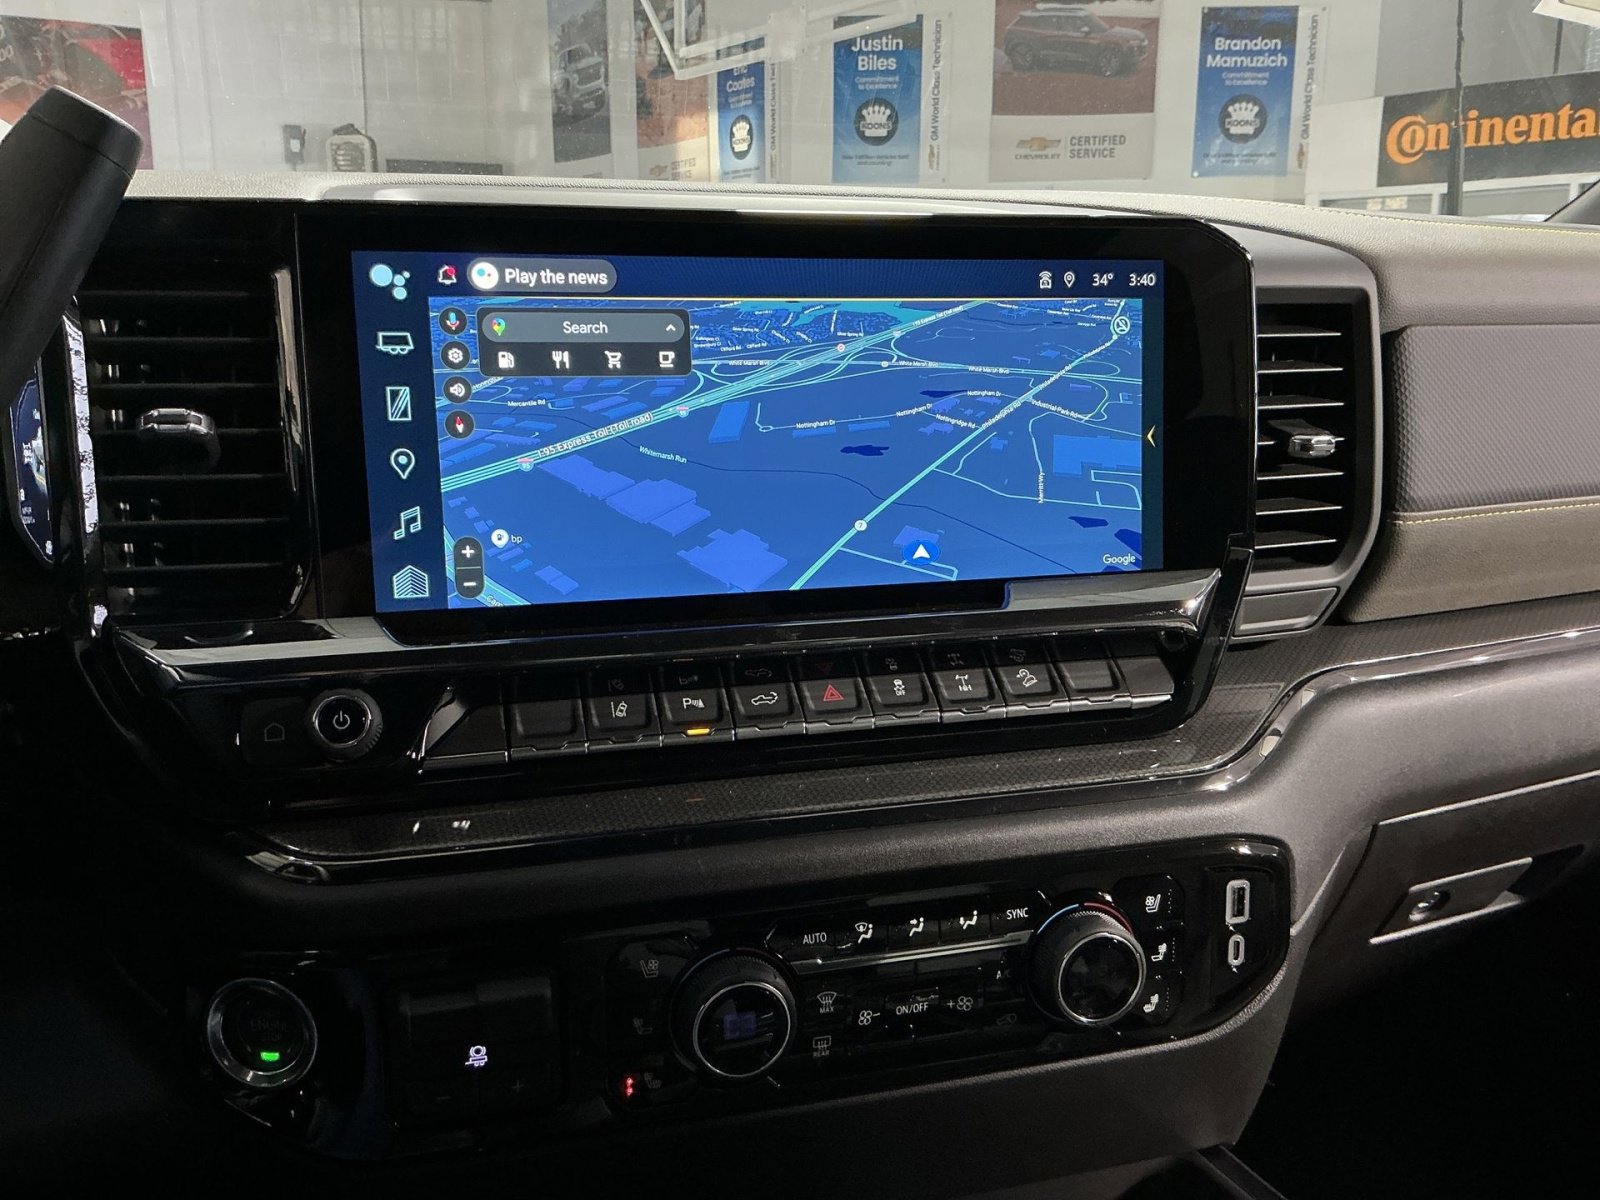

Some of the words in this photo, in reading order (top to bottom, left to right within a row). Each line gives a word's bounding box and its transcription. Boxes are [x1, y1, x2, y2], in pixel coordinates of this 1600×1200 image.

[851, 35, 903, 52] Justin
[932, 19, 942, 70] Technician
[1214, 36, 1281, 51] Brandon
[1306, 14, 1319, 67] Technician
[858, 54, 897, 71] Biles
[1206, 52, 1288, 68] Mamuzich
[726, 77, 755, 93] Coates
[932, 71, 940, 96] Class
[931, 97, 940, 125] World
[861, 122, 891, 130] KOONS
[1386, 99, 1600, 165] Coninenta
[1069, 135, 1127, 147] CERTIFIED
[1069, 148, 1116, 159] SERVICE
[504, 269, 538, 287] Play
[540, 269, 565, 284] the
[568, 273, 608, 285] news
[1129, 273, 1156, 286] 3:40
[563, 320, 608, 334] Search
[896, 407, 926, 417] Nottingham
[982, 405, 1014, 428] Philadelphia
[1013, 401, 1021, 410] Rd
[1032, 400, 1058, 412] Industrial
[1058, 405, 1071, 415] Park
[1071, 410, 1079, 418] Rd
[796, 421, 829, 429] Nottingham
[936, 413, 967, 427] Nottingridge
[968, 421, 976, 429] Rd
[557, 435, 592, 450] Express
[593, 427, 609, 439] Toll
[610, 421, 629, 435] (Toll
[631, 411, 654, 426] road)
[639, 445, 674, 461] Whitemarsh
[674, 454, 687, 464] Run
[511, 534, 523, 544] bp
[1103, 554, 1136, 566] Google
[1006, 908, 1029, 920] SYNC
[803, 932, 827, 945] AUTO
[819, 1006, 834, 1014] MAX
[896, 1002, 929, 1016] ON/OFF
